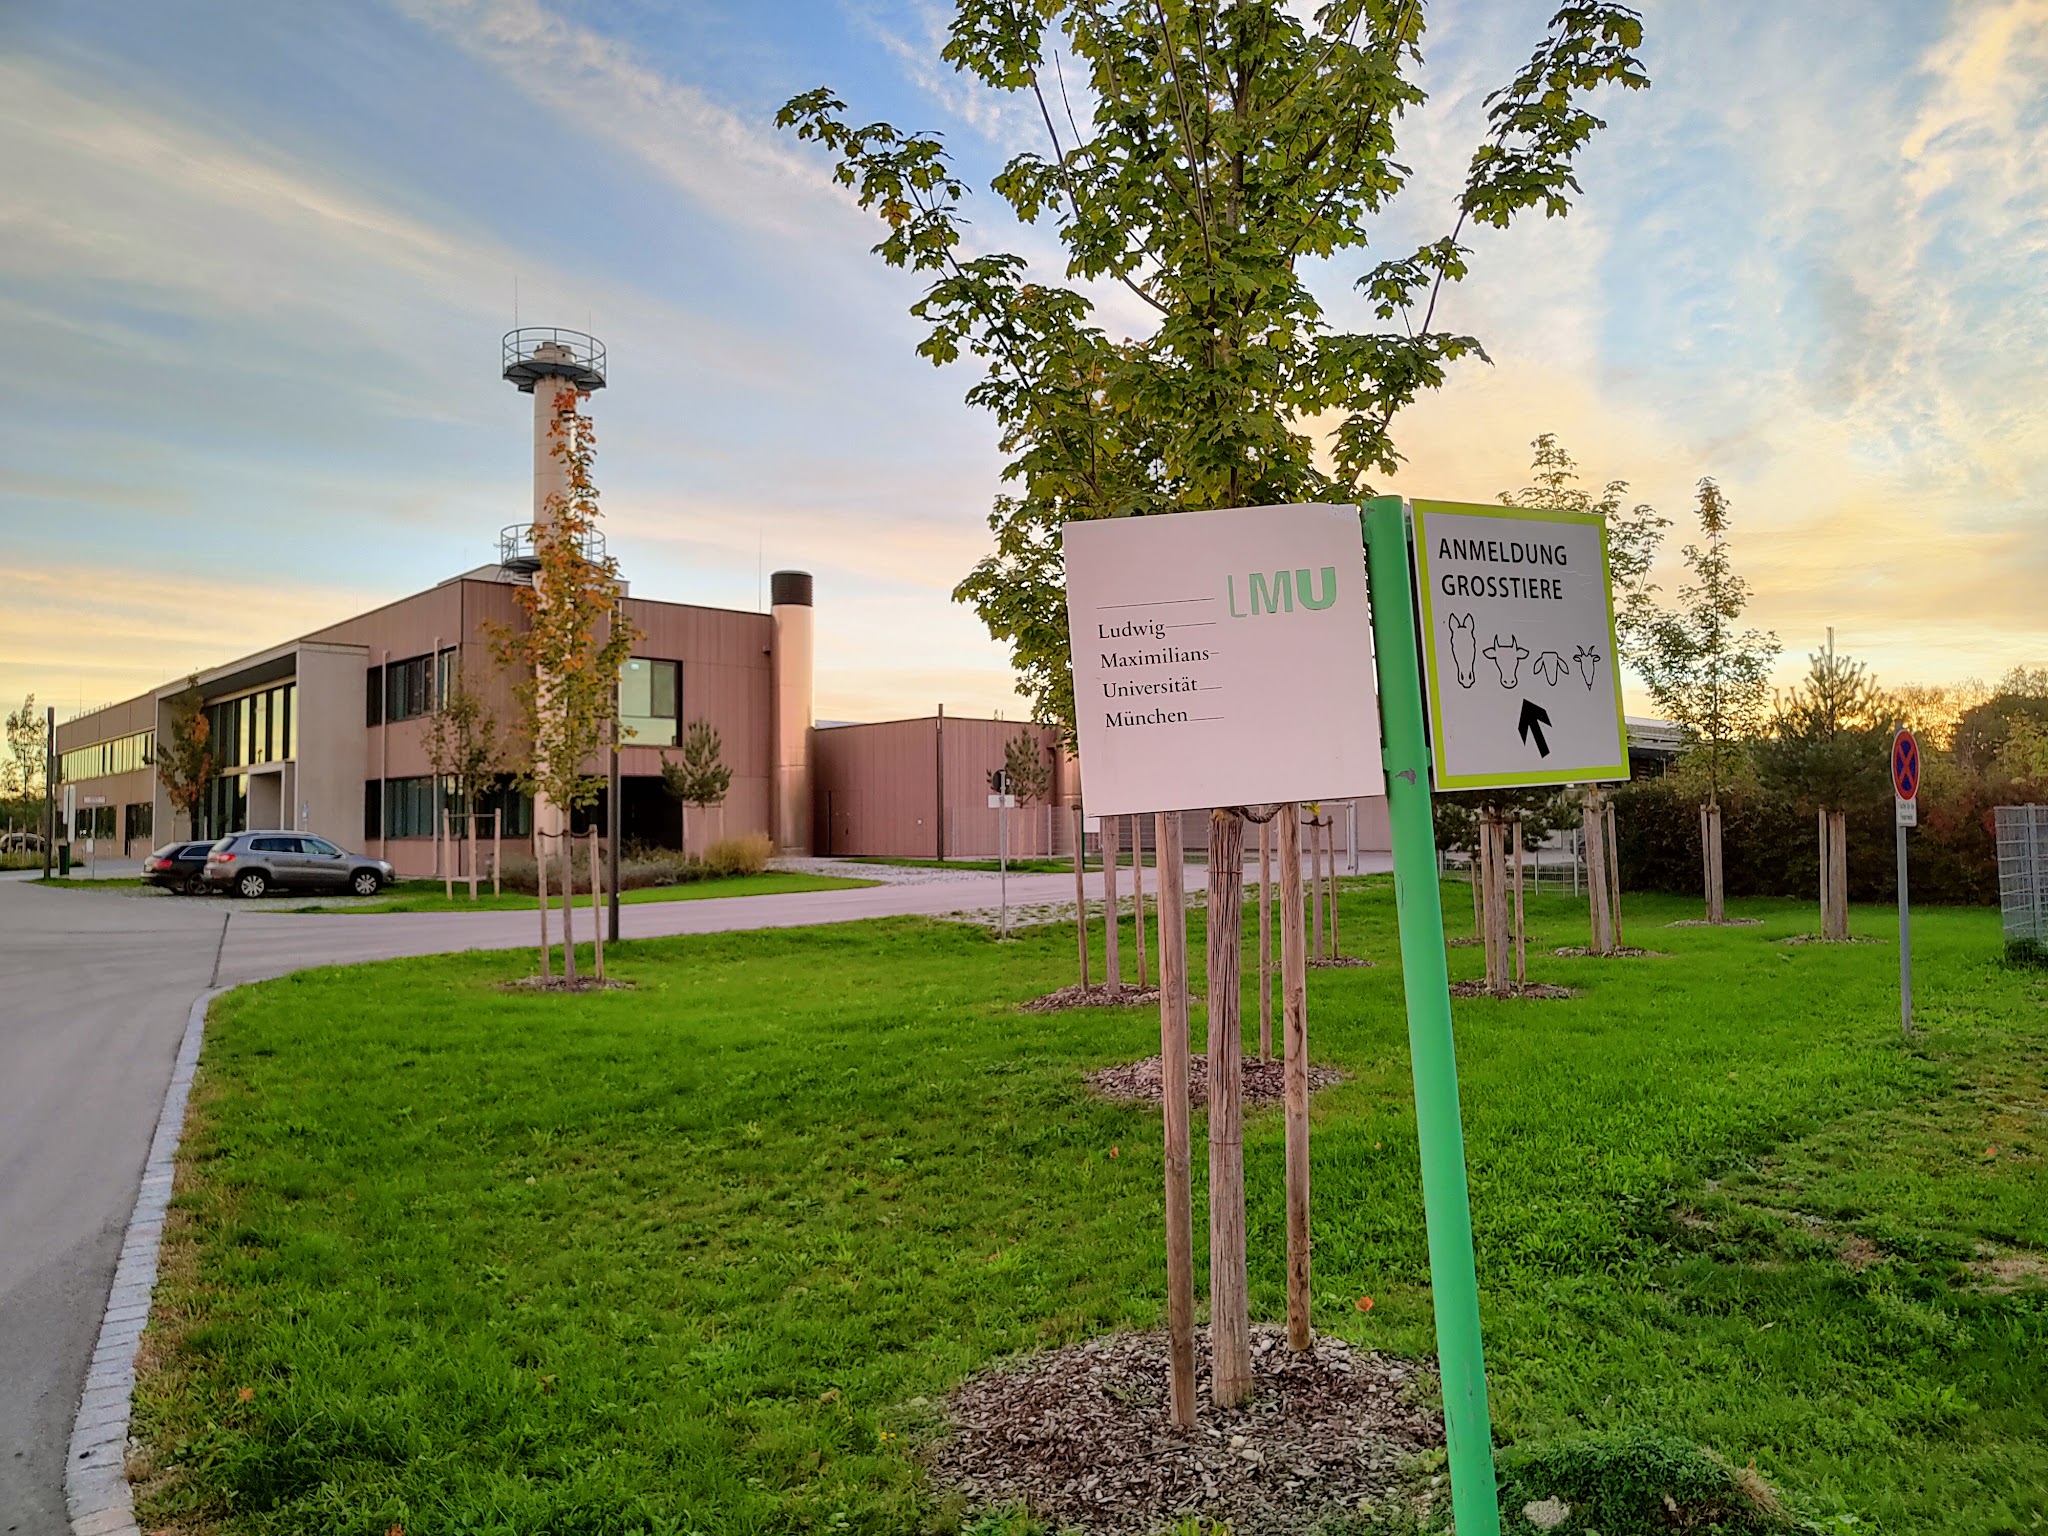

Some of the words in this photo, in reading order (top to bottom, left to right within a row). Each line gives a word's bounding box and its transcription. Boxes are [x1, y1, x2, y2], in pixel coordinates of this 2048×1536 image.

[1438, 537, 1568, 567] ANMELDUNG
[1227, 566, 1337, 619] LMU
[1441, 574, 1563, 600] GROSSTIERE
[1102, 676, 1199, 698] Universität
[1105, 708, 1189, 728] München
